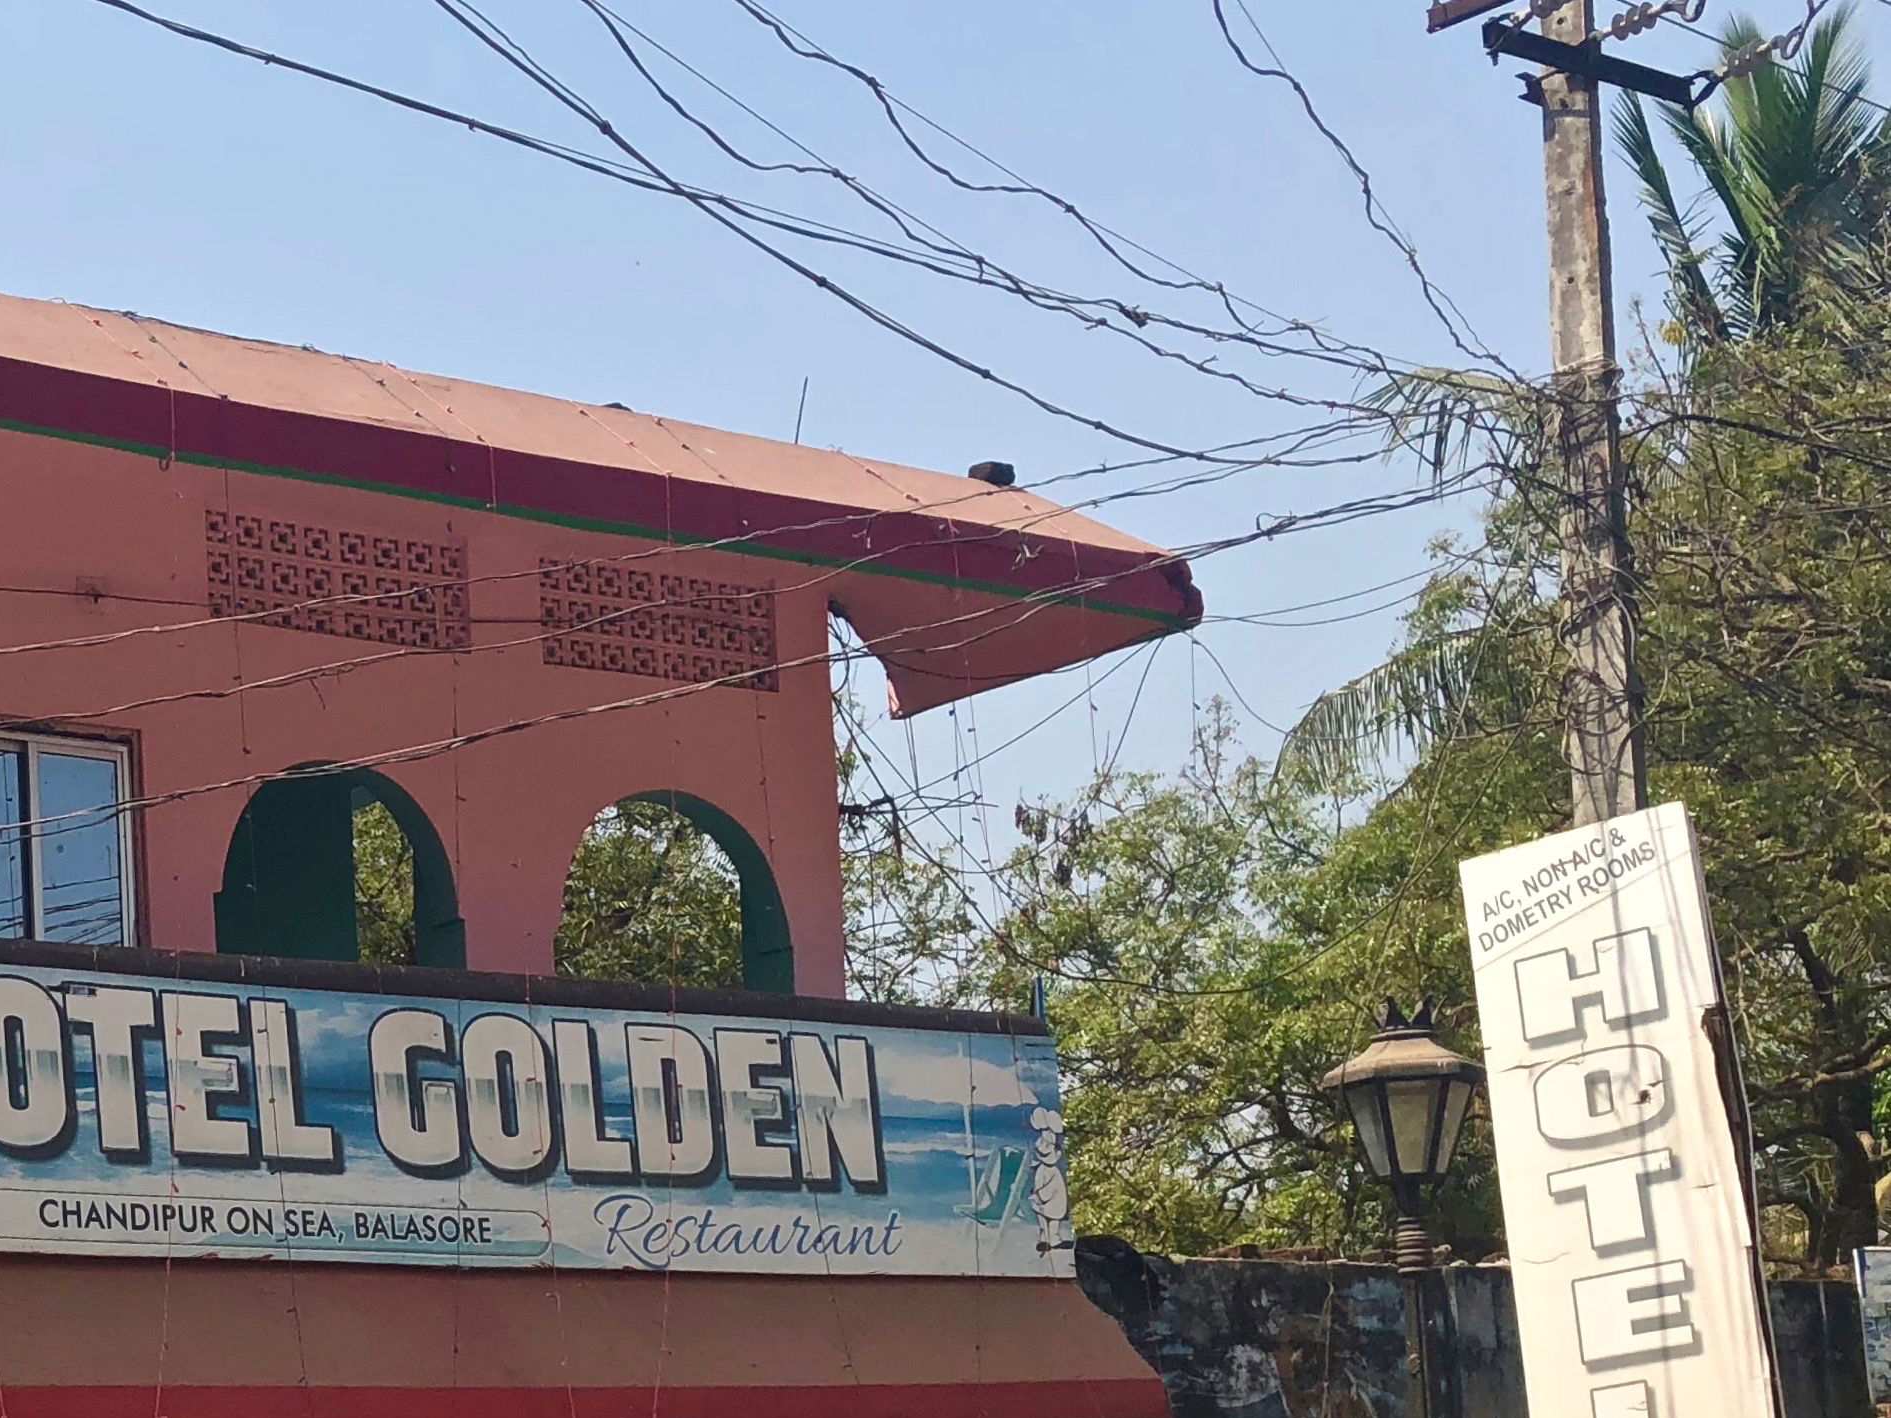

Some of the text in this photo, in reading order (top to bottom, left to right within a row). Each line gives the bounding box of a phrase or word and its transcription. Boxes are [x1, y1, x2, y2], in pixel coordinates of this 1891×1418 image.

[1477, 841, 1656, 952] DOMETRY ROOMS
[1481, 890, 1522, 922] A/C,
[1609, 827, 1626, 848] &
[368, 1007, 887, 1193] GOLDEN
[38, 1198, 493, 1247] CHANDIPUR ON SEA, BALASORE
[593, 1194, 903, 1270] Restaurant
